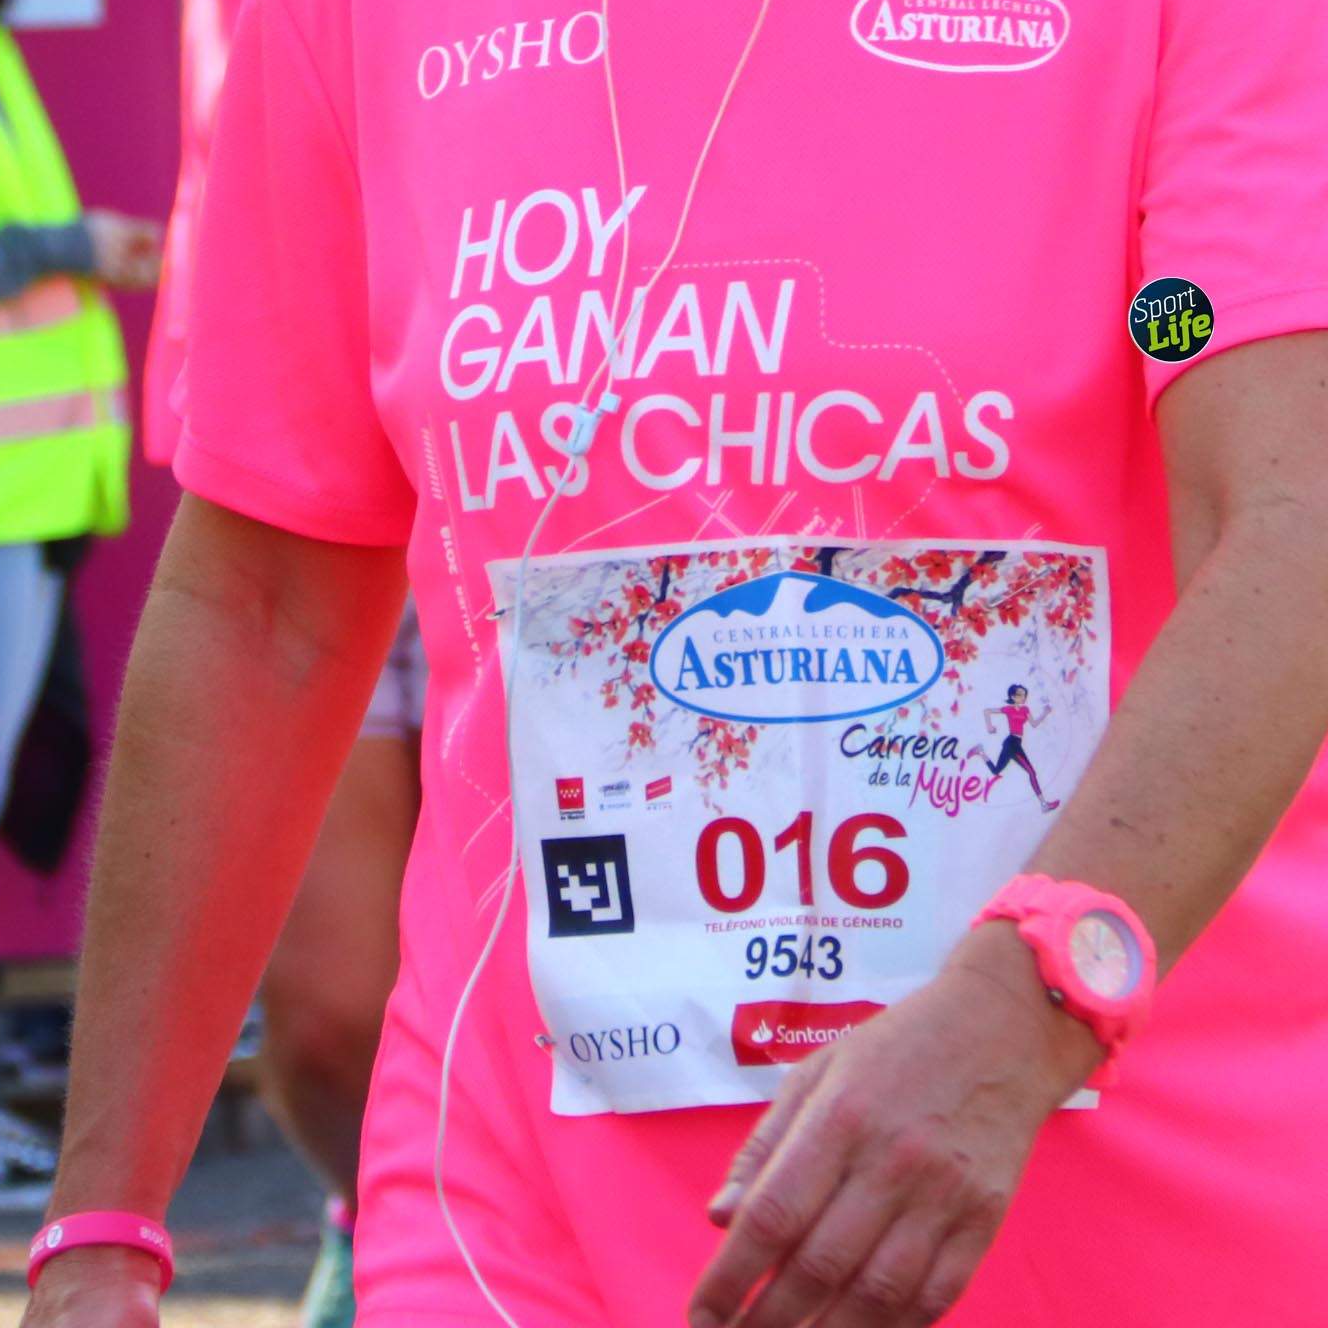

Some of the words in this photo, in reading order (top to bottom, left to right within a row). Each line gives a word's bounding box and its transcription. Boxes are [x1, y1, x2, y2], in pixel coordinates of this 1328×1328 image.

[417, 10, 605, 100] OYSHO
[449, 183, 648, 299] HOY
[439, 279, 795, 401] GANAN
[448, 401, 590, 513] LAS
[620, 388, 1014, 491] CHICAS
[713, 624, 804, 644] CENTRAL
[811, 623, 910, 640] LECHERA
[673, 635, 921, 692] ASTURIANA
[840, 723, 960, 760] Carrera
[868, 762, 890, 787] de
[895, 762, 911, 787] la
[908, 759, 1004, 817] Mujer
[695, 810, 911, 914] 016
[704, 916, 766, 933] TELÉFONO
[821, 915, 839, 929] DE
[842, 914, 904, 930] GÉNERO
[745, 934, 844, 981] 9543
[569, 1021, 681, 1063] OYSHO
[776, 1023, 859, 1045] Santand
